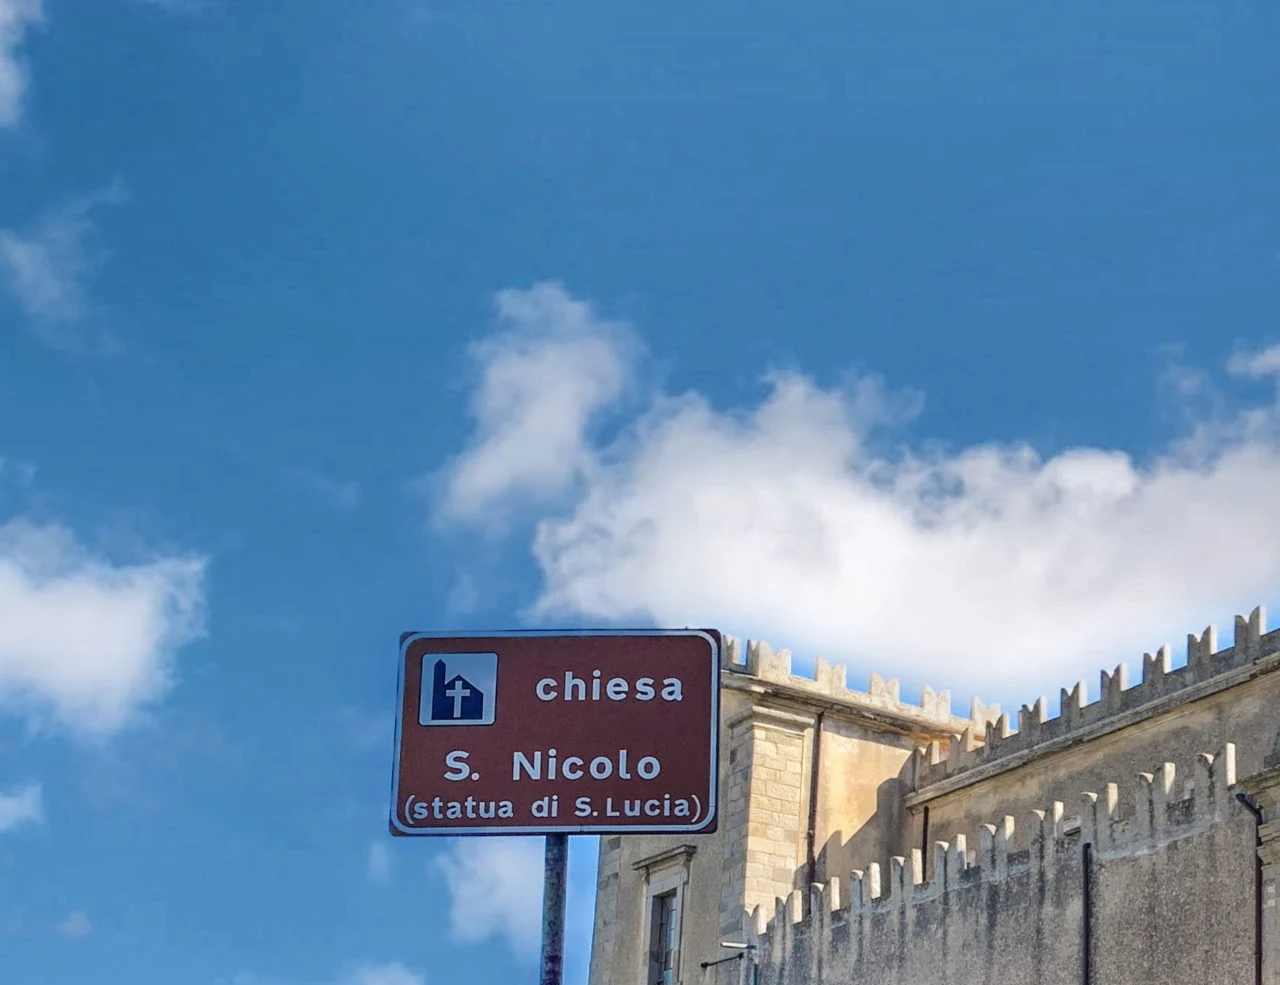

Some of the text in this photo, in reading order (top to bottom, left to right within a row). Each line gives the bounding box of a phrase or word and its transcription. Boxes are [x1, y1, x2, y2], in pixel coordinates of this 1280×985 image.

[535, 669, 684, 701] chiesa
[443, 748, 662, 781] S. Nicolo
[404, 795, 514, 825] (statua
[531, 795, 558, 818] di
